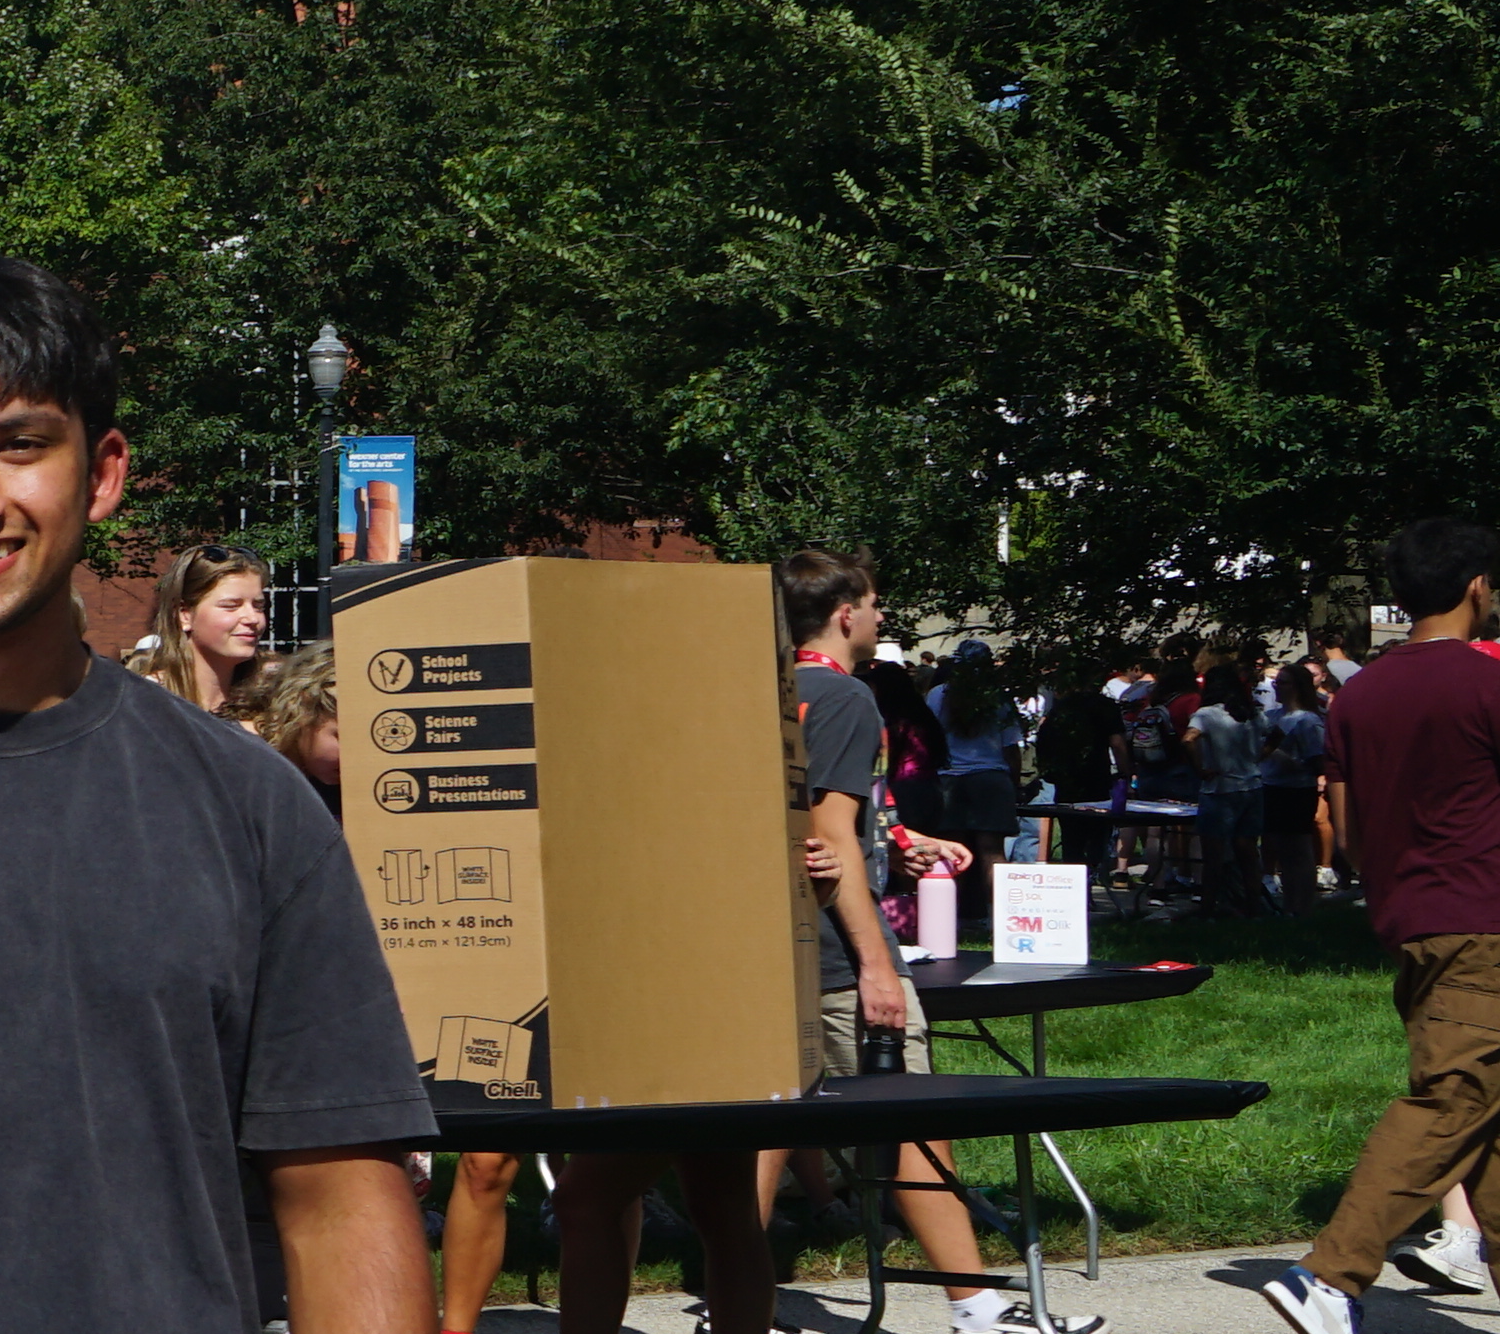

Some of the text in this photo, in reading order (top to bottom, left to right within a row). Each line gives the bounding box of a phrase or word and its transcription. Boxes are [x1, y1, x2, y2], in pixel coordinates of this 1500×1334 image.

[422, 654, 467, 668] School
[423, 670, 482, 685] Projects
[424, 715, 477, 729] Science
[426, 730, 462, 744] Fairs
[428, 774, 490, 789] Business
[429, 788, 526, 803] Presentations
[380, 918, 398, 931] 36
[404, 916, 436, 930] inch
[456, 916, 476, 928] 48
[481, 915, 513, 928] inch
[1006, 916, 1043, 933] 3M
[384, 937, 415, 950] (91.4
[418, 939, 437, 948] cm
[1018, 938, 1035, 953] R
